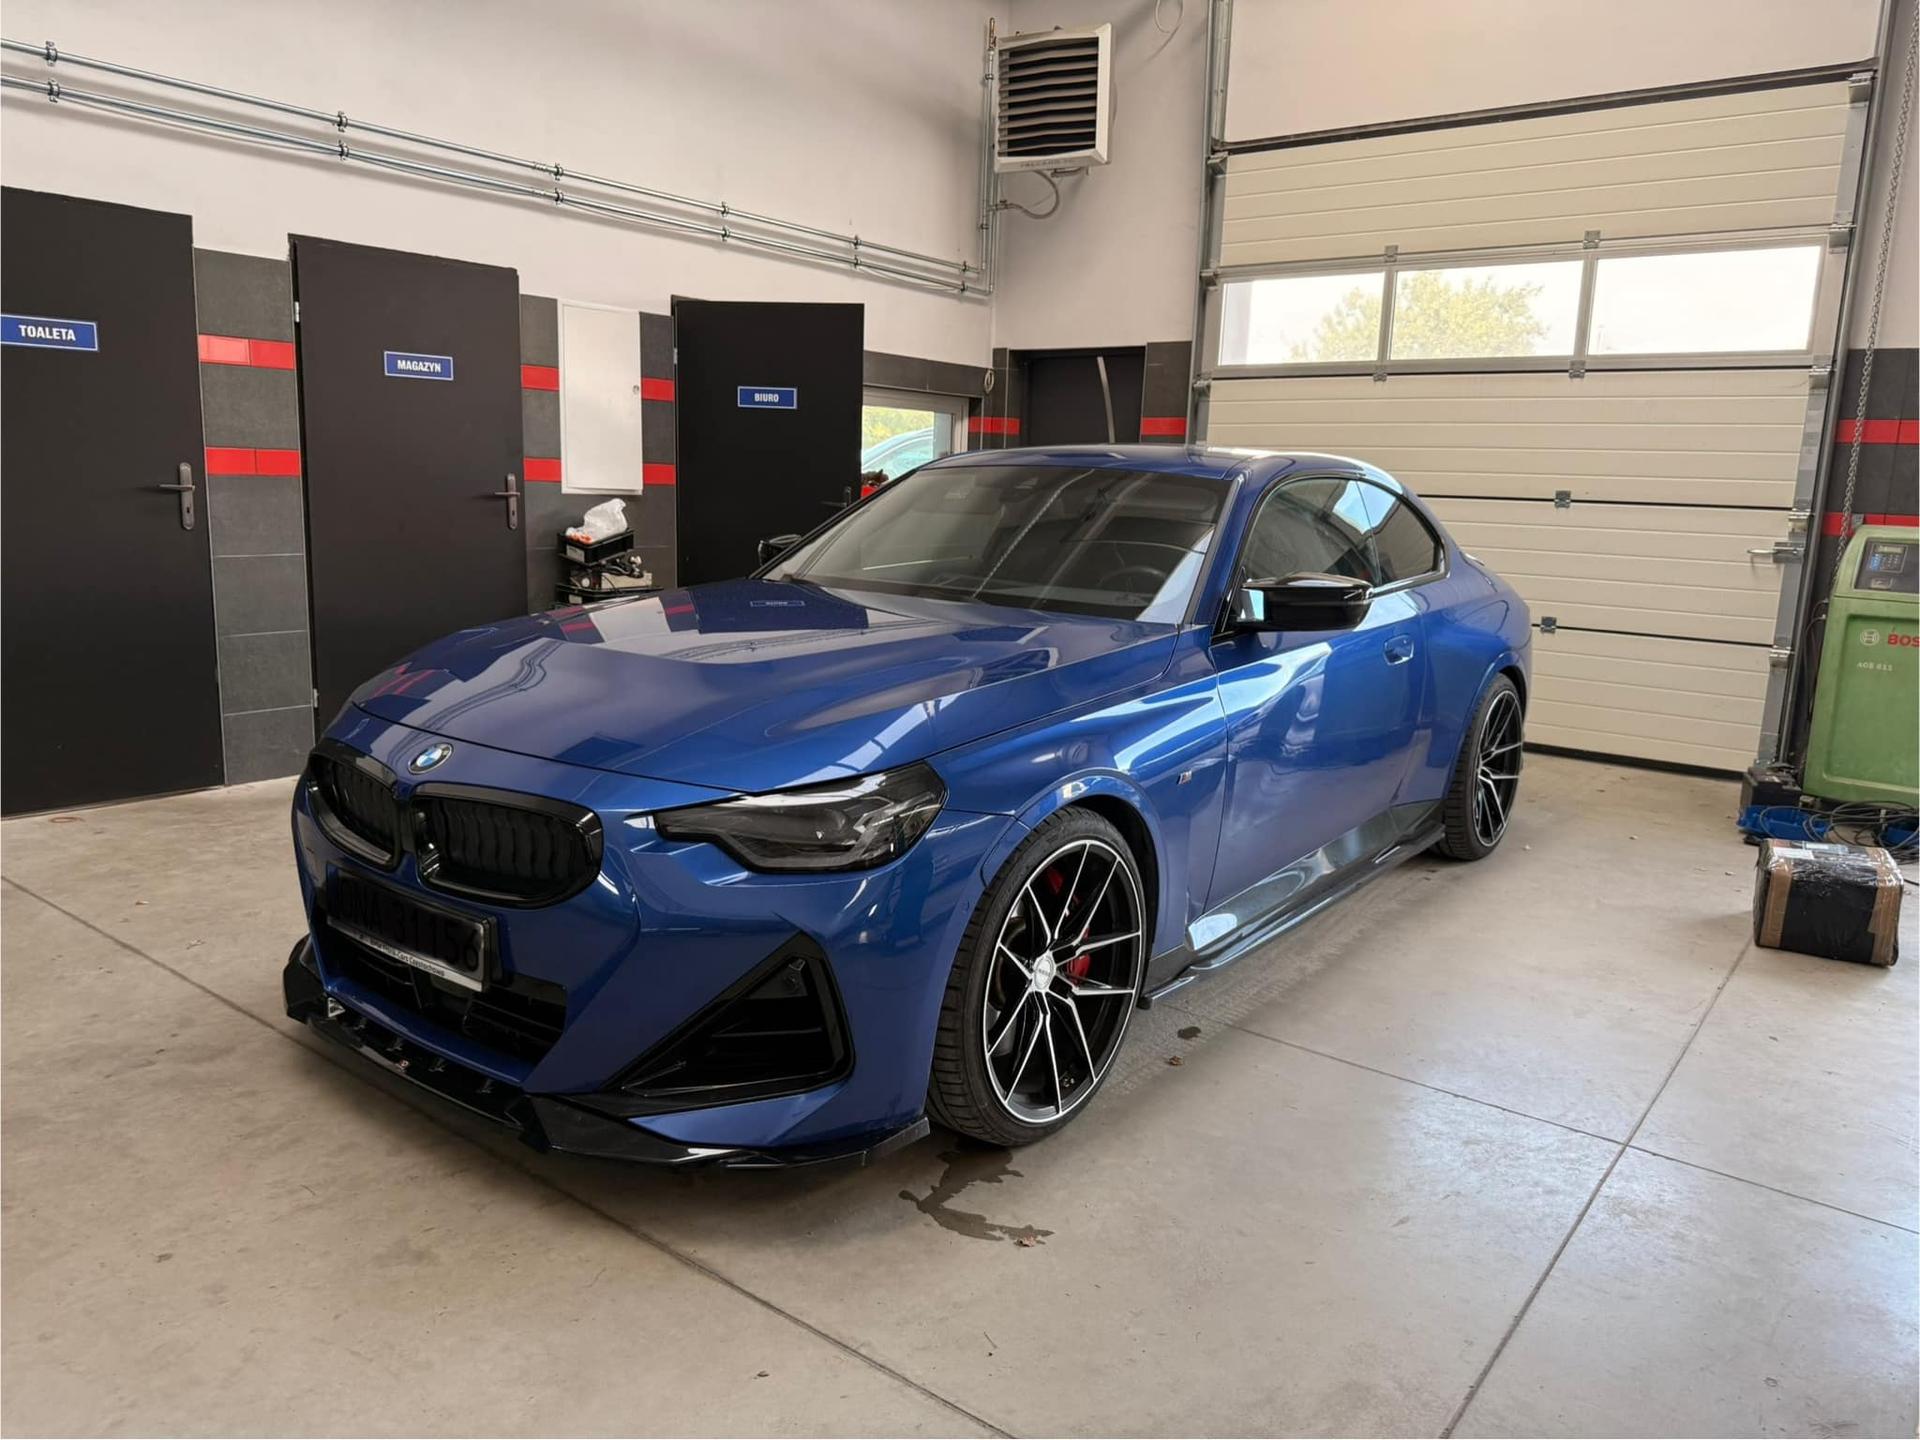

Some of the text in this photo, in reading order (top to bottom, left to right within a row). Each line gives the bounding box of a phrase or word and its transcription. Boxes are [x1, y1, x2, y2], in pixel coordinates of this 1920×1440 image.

[18, 324, 76, 341] TOALETA
[397, 359, 441, 373] MAGAZYN
[754, 392, 779, 403] BIURO
